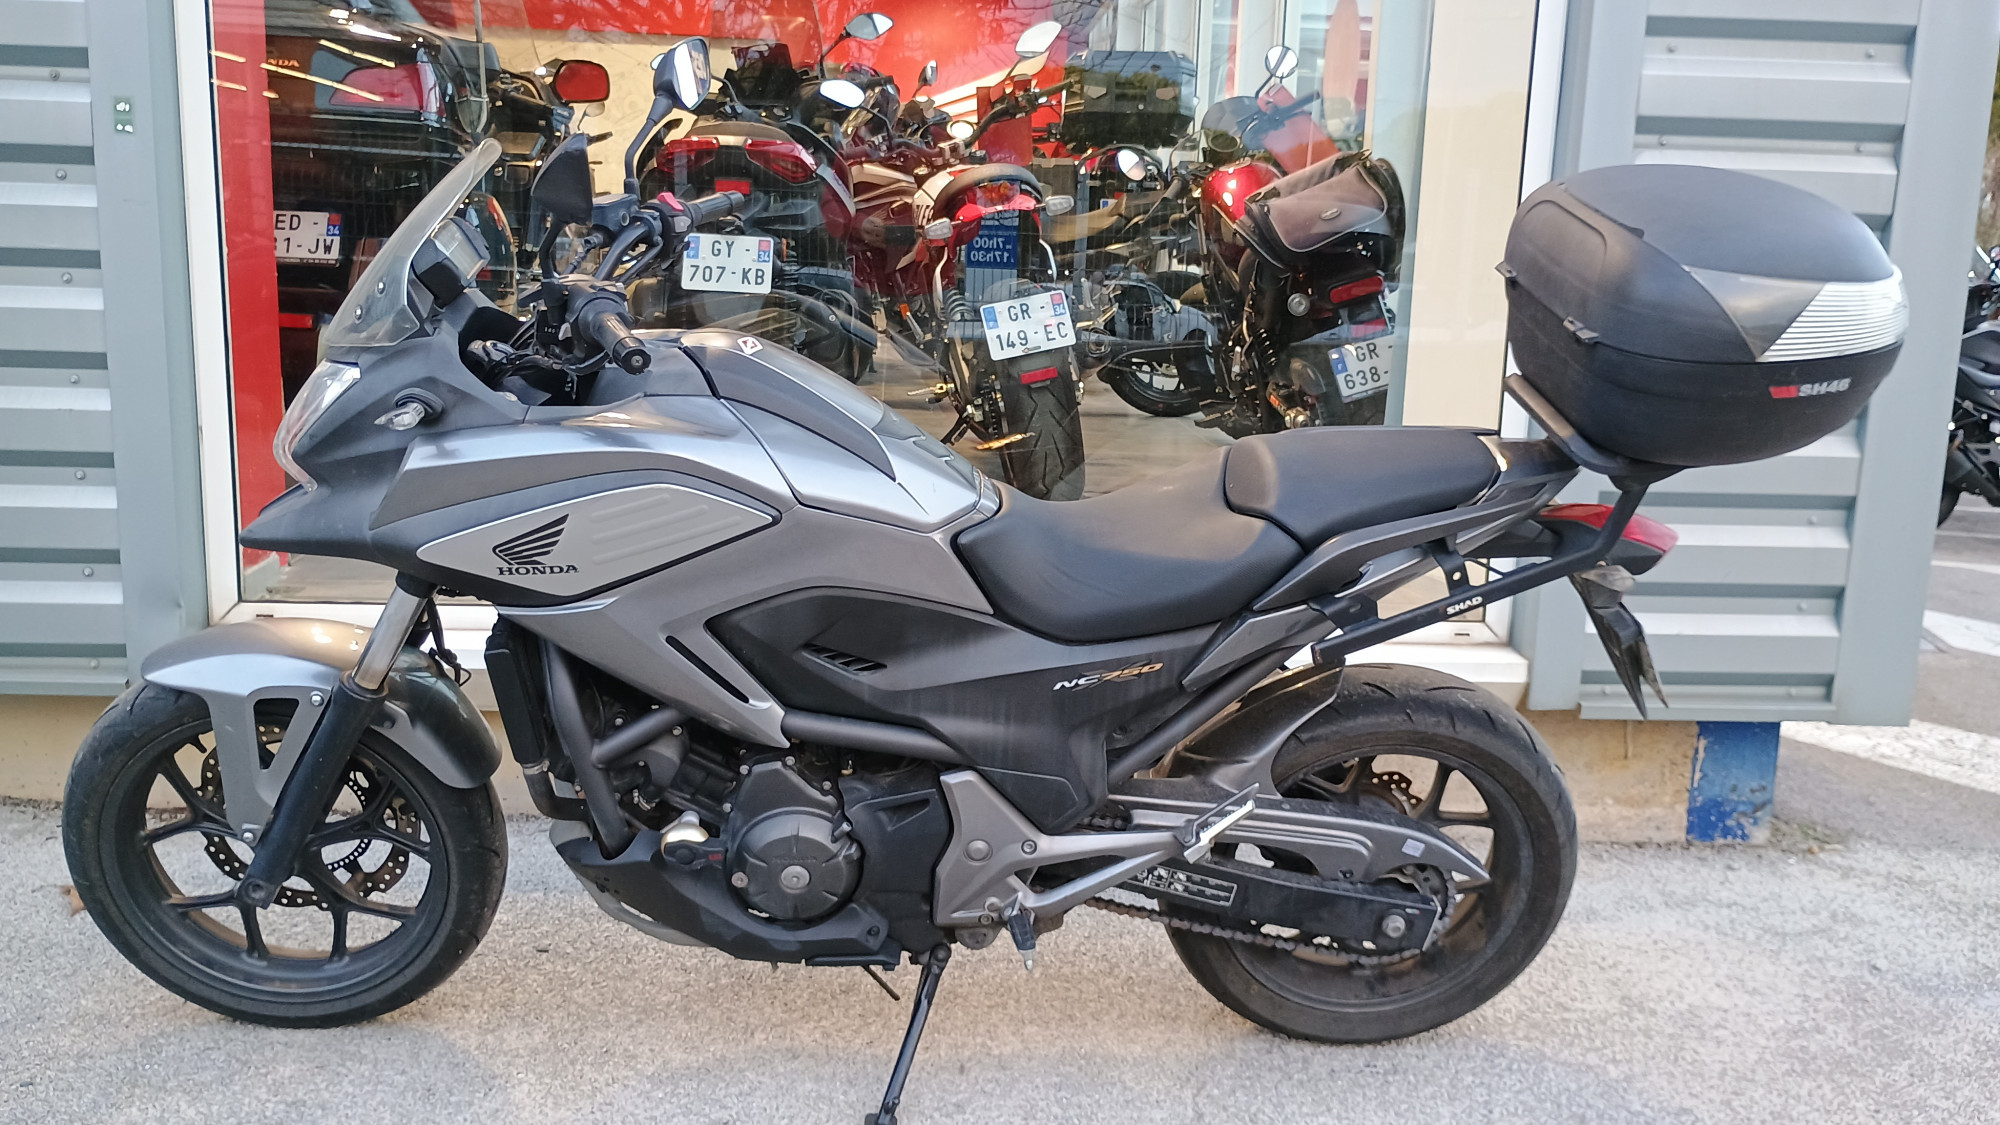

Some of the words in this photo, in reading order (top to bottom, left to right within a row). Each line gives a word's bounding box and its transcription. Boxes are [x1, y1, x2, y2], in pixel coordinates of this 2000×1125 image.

[327, 225, 340, 235] 34
[274, 237, 335, 255] 1-JW
[758, 251, 770, 262] 34
[689, 264, 766, 286] 707-KB
[1053, 304, 1066, 315] 34
[995, 321, 1069, 352] 149-EC
[496, 564, 579, 576] HONDA
[1446, 596, 1483, 615] SHAD
